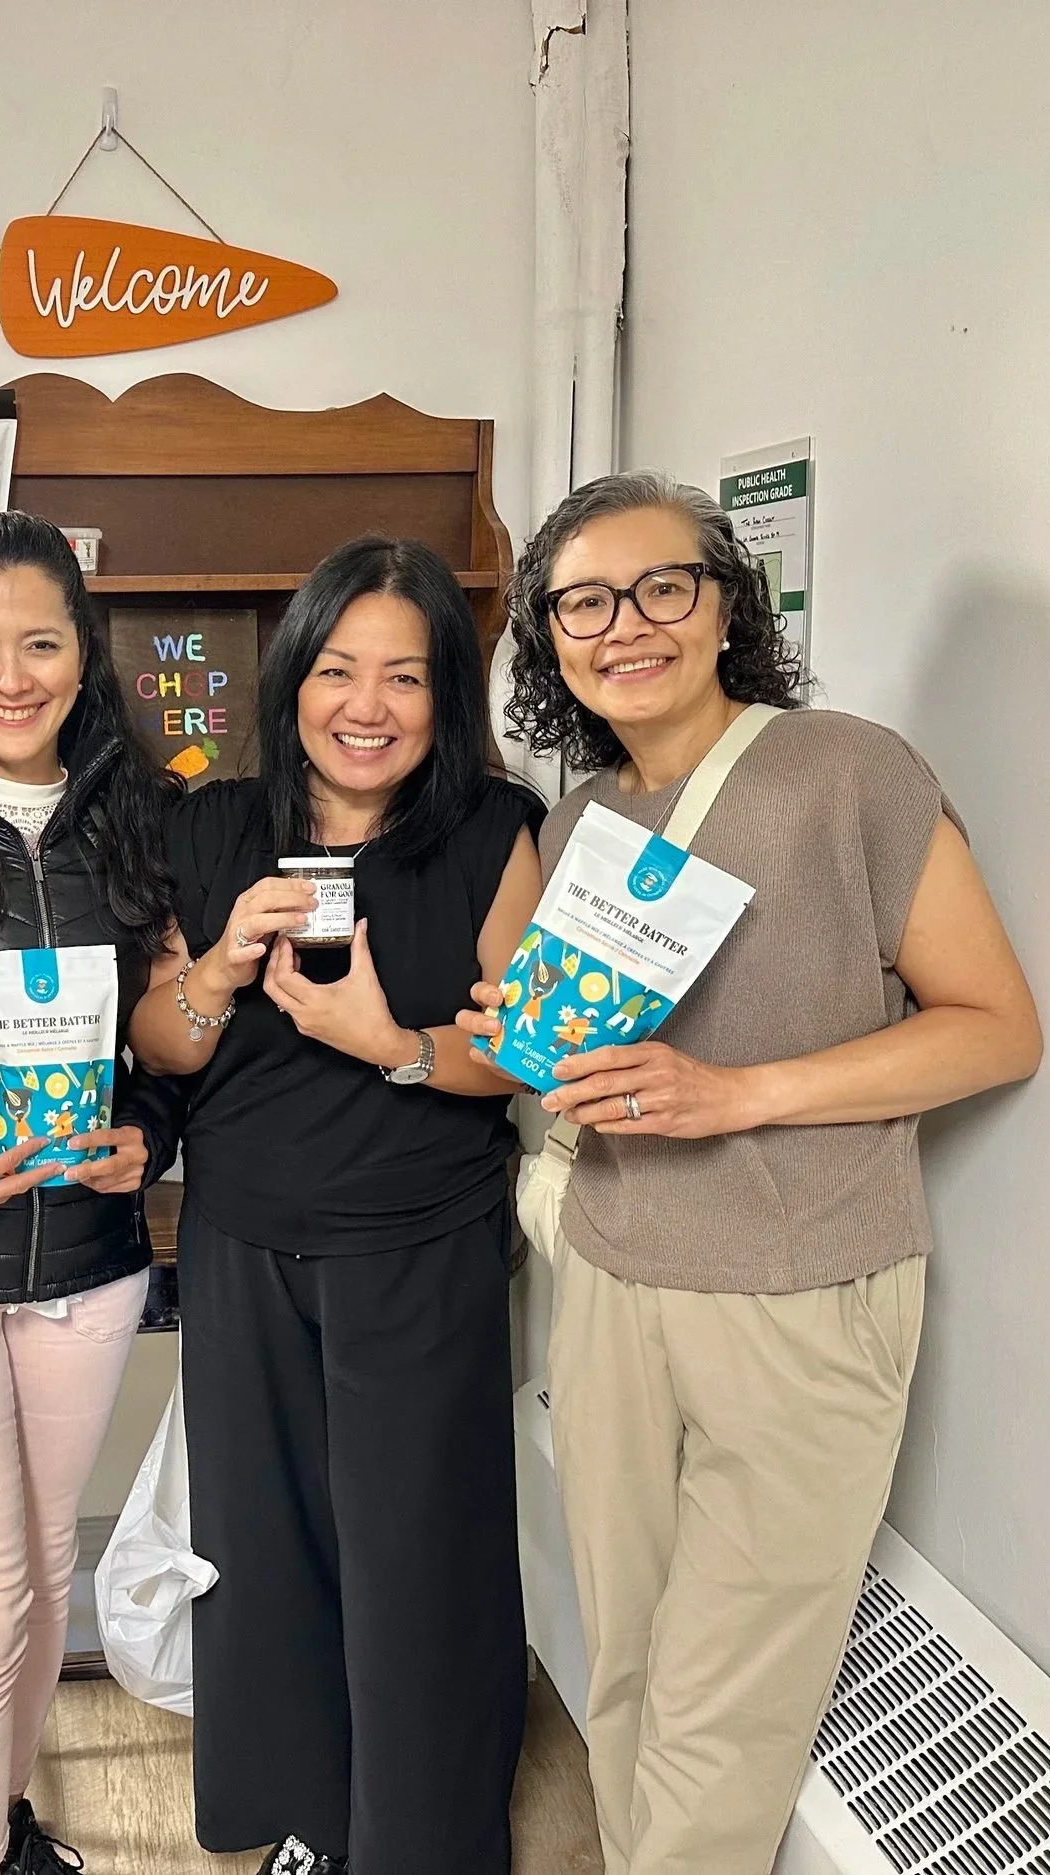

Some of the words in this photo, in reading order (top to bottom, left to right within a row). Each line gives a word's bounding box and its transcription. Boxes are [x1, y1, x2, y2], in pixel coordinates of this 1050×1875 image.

[27, 247, 269, 328] Welcome
[738, 474, 760, 490] PUBLIC
[761, 468, 786, 485] HEALTH
[732, 490, 768, 507] INSPECTION
[770, 484, 793, 500] GRADE
[153, 633, 206, 662] WE
[136, 670, 228, 699] CHOP
[140, 708, 228, 736] ERE
[568, 882, 588, 902] THE
[590, 895, 640, 930] BETTER
[640, 923, 688, 957] BATTER
[13, 1017, 57, 1029] BETTER
[60, 1014, 100, 1026] BATTER
[525, 1046, 546, 1064] CARROT
[521, 1058, 538, 1071] 400
[539, 1069, 545, 1078] g
